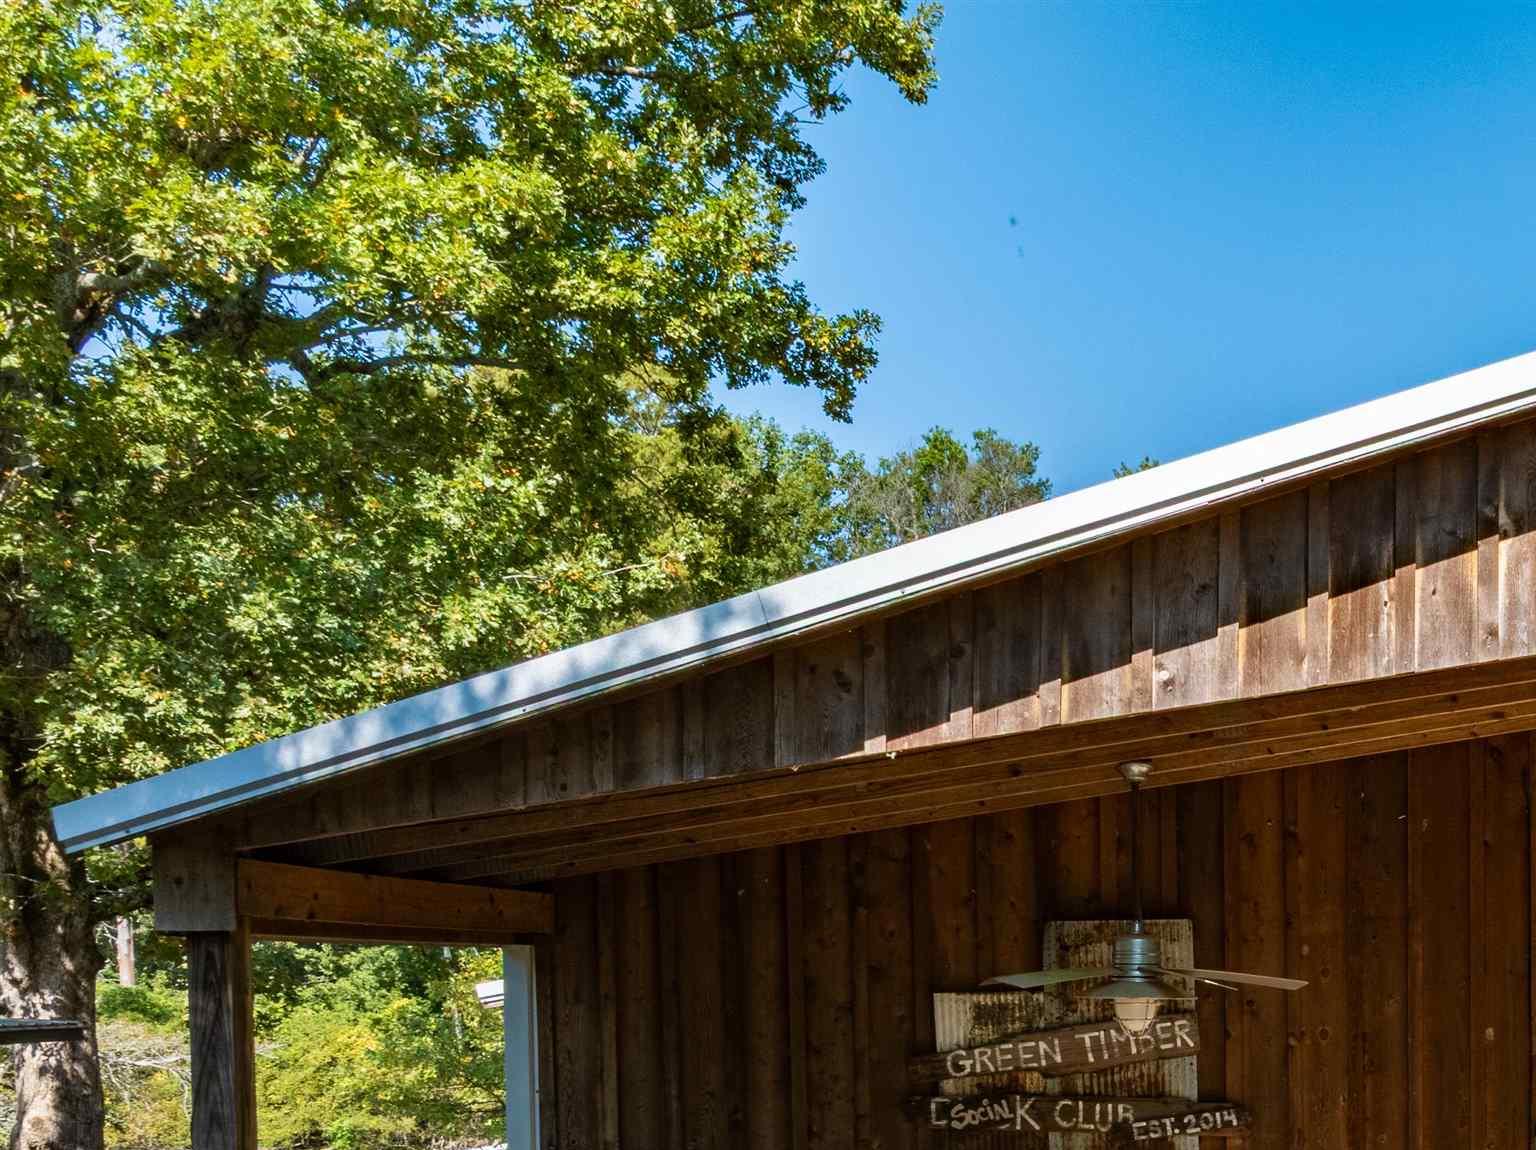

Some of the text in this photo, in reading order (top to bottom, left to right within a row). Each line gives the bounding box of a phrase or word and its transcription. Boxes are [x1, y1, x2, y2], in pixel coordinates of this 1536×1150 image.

[946, 1020, 1195, 1077] GREEN TIMBER
[1132, 1109, 1239, 1141] EST. 2014
